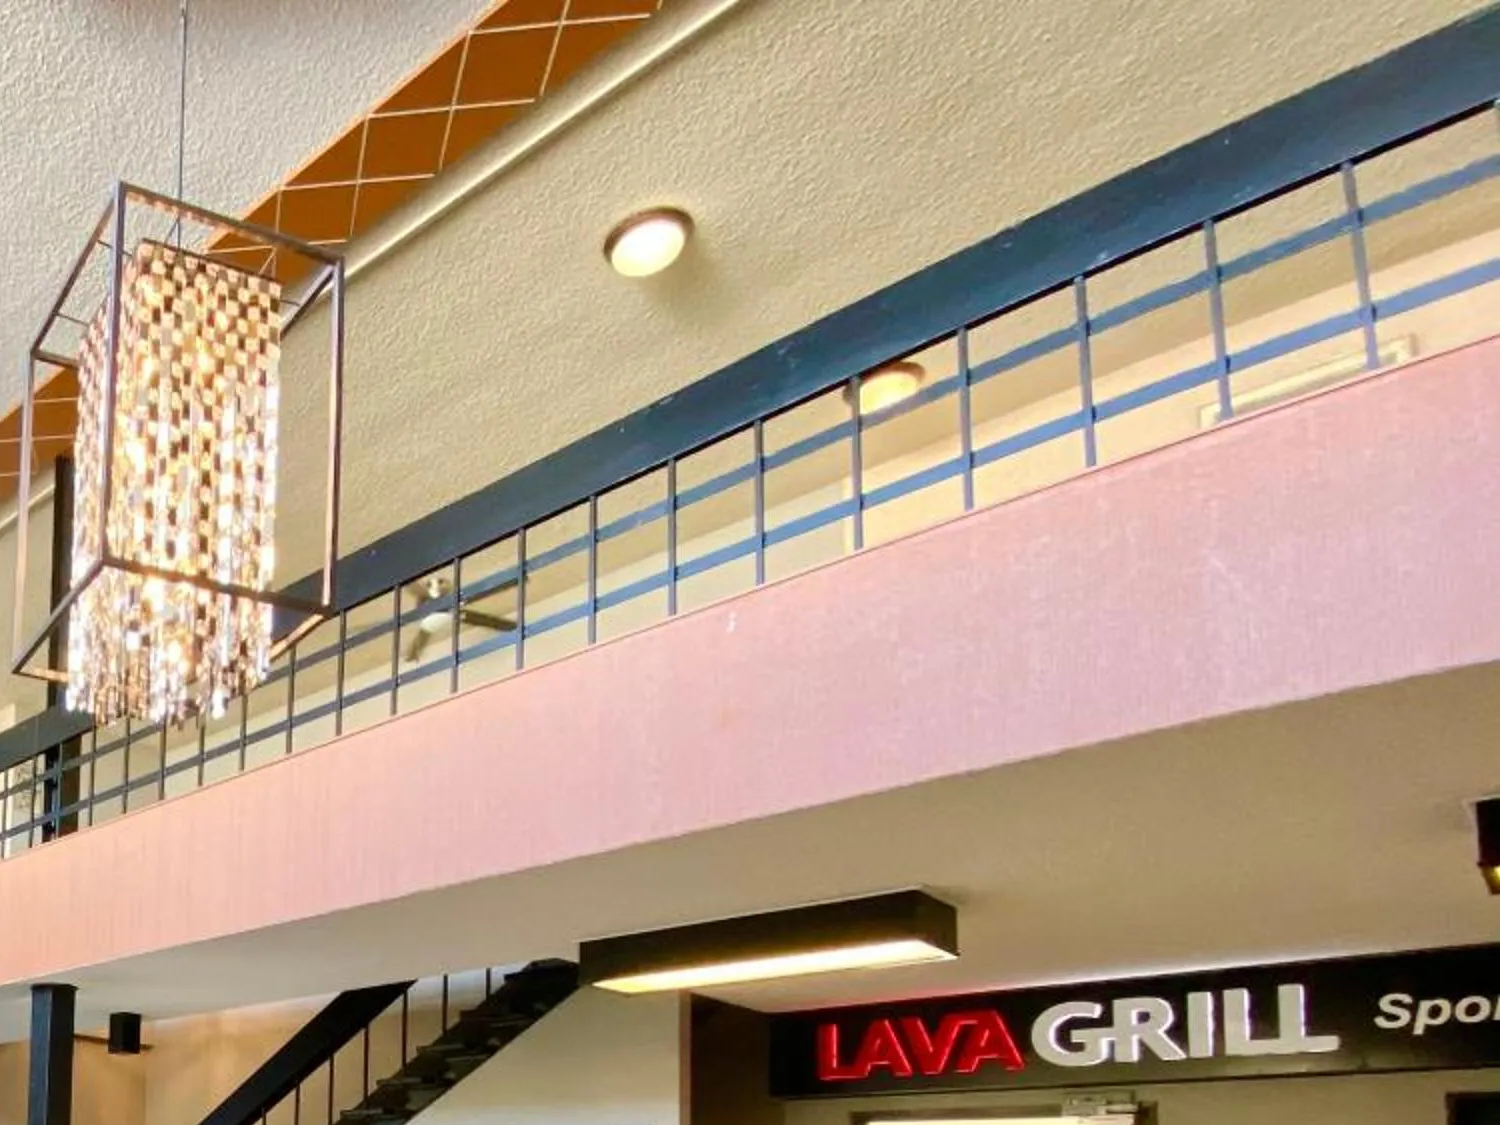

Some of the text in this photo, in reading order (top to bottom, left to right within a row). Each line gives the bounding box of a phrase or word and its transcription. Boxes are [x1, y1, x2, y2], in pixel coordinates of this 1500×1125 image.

[818, 983, 1500, 1080] LAVA GRILL Spo
